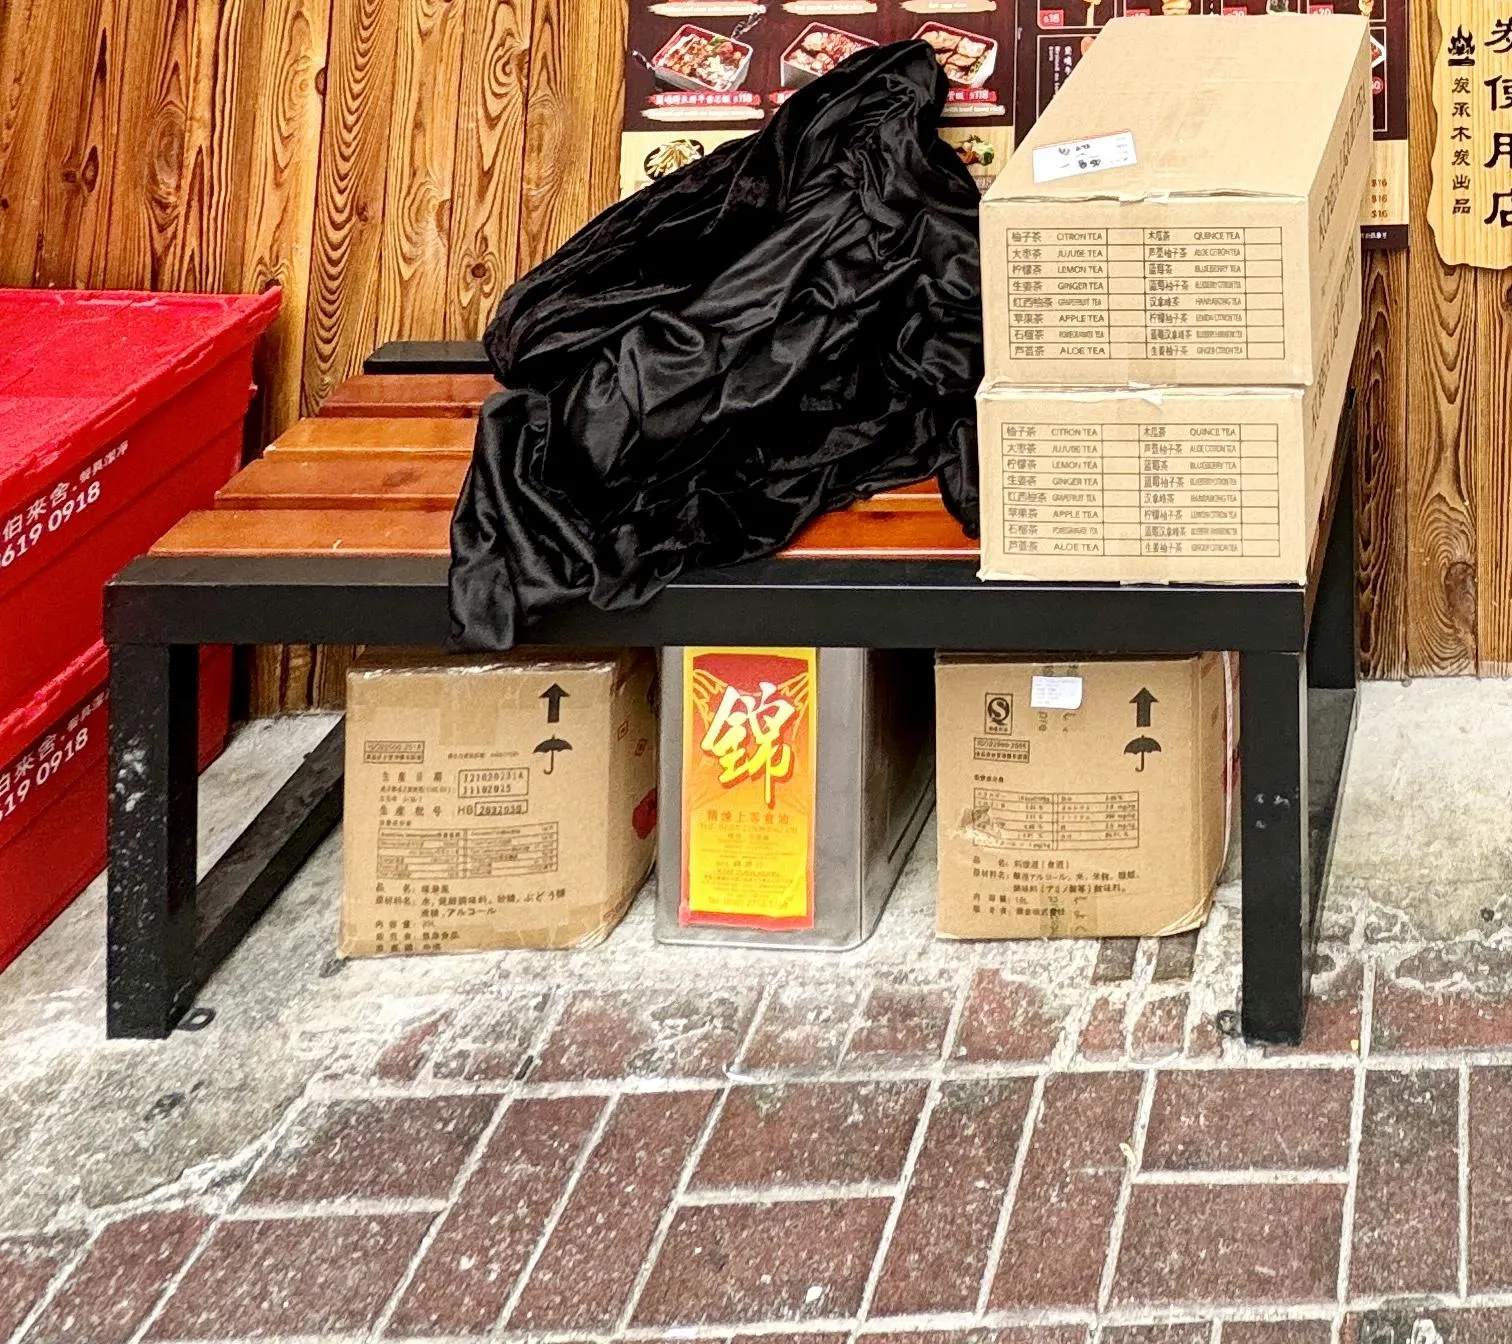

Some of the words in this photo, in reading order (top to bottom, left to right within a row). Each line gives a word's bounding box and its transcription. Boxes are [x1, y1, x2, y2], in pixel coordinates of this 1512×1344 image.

[1089, 282, 1103, 290] TEA
[1060, 347, 1084, 355] ALOE
[1084, 478, 1098, 486] TEA
[0, 523, 43, 568] 619
[48, 480, 103, 532] 0918
[703, 681, 797, 809] 錦
[0, 778, 31, 822] 19
[35, 726, 89, 785] 0918
